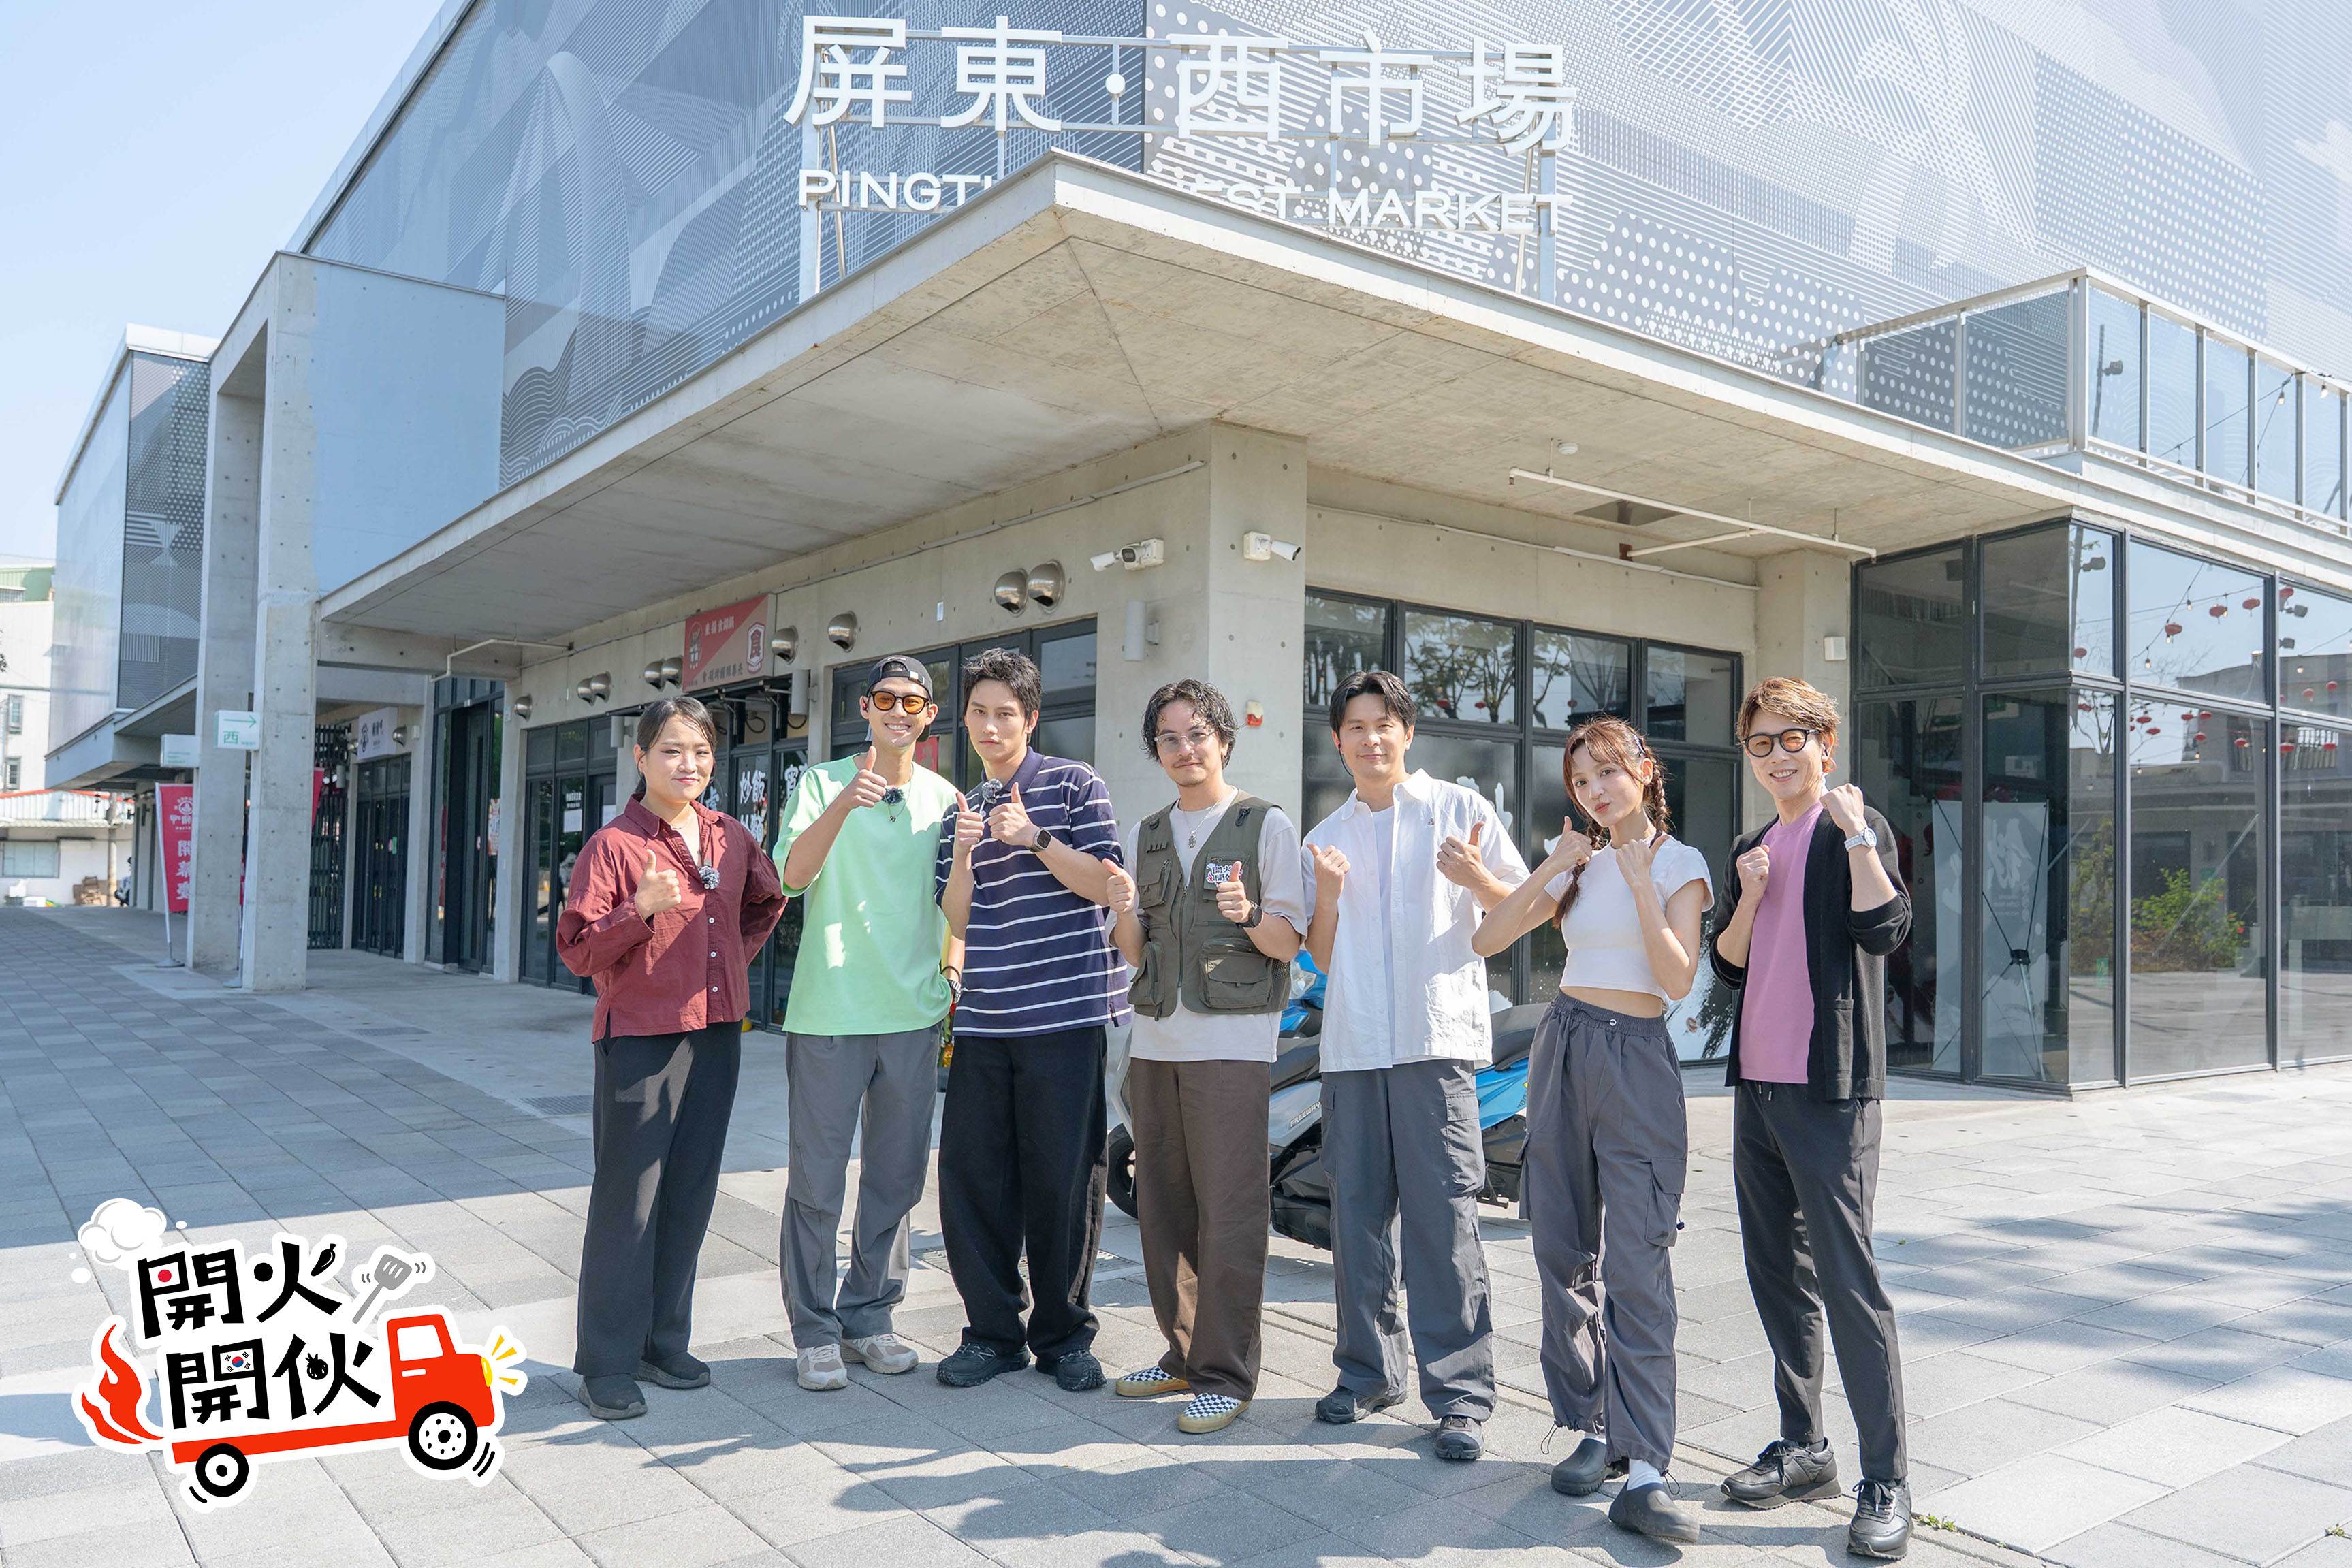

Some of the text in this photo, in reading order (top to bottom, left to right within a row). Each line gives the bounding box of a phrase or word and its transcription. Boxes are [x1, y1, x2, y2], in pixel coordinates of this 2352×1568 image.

[799, 169, 992, 211] PINGT
[1328, 187, 1574, 235] MARKET
[223, 731, 239, 744] 西
[740, 769, 766, 804] 炒飯
[784, 763, 808, 801] 宵
[1290, 1101, 1321, 1128] FREEWAY
